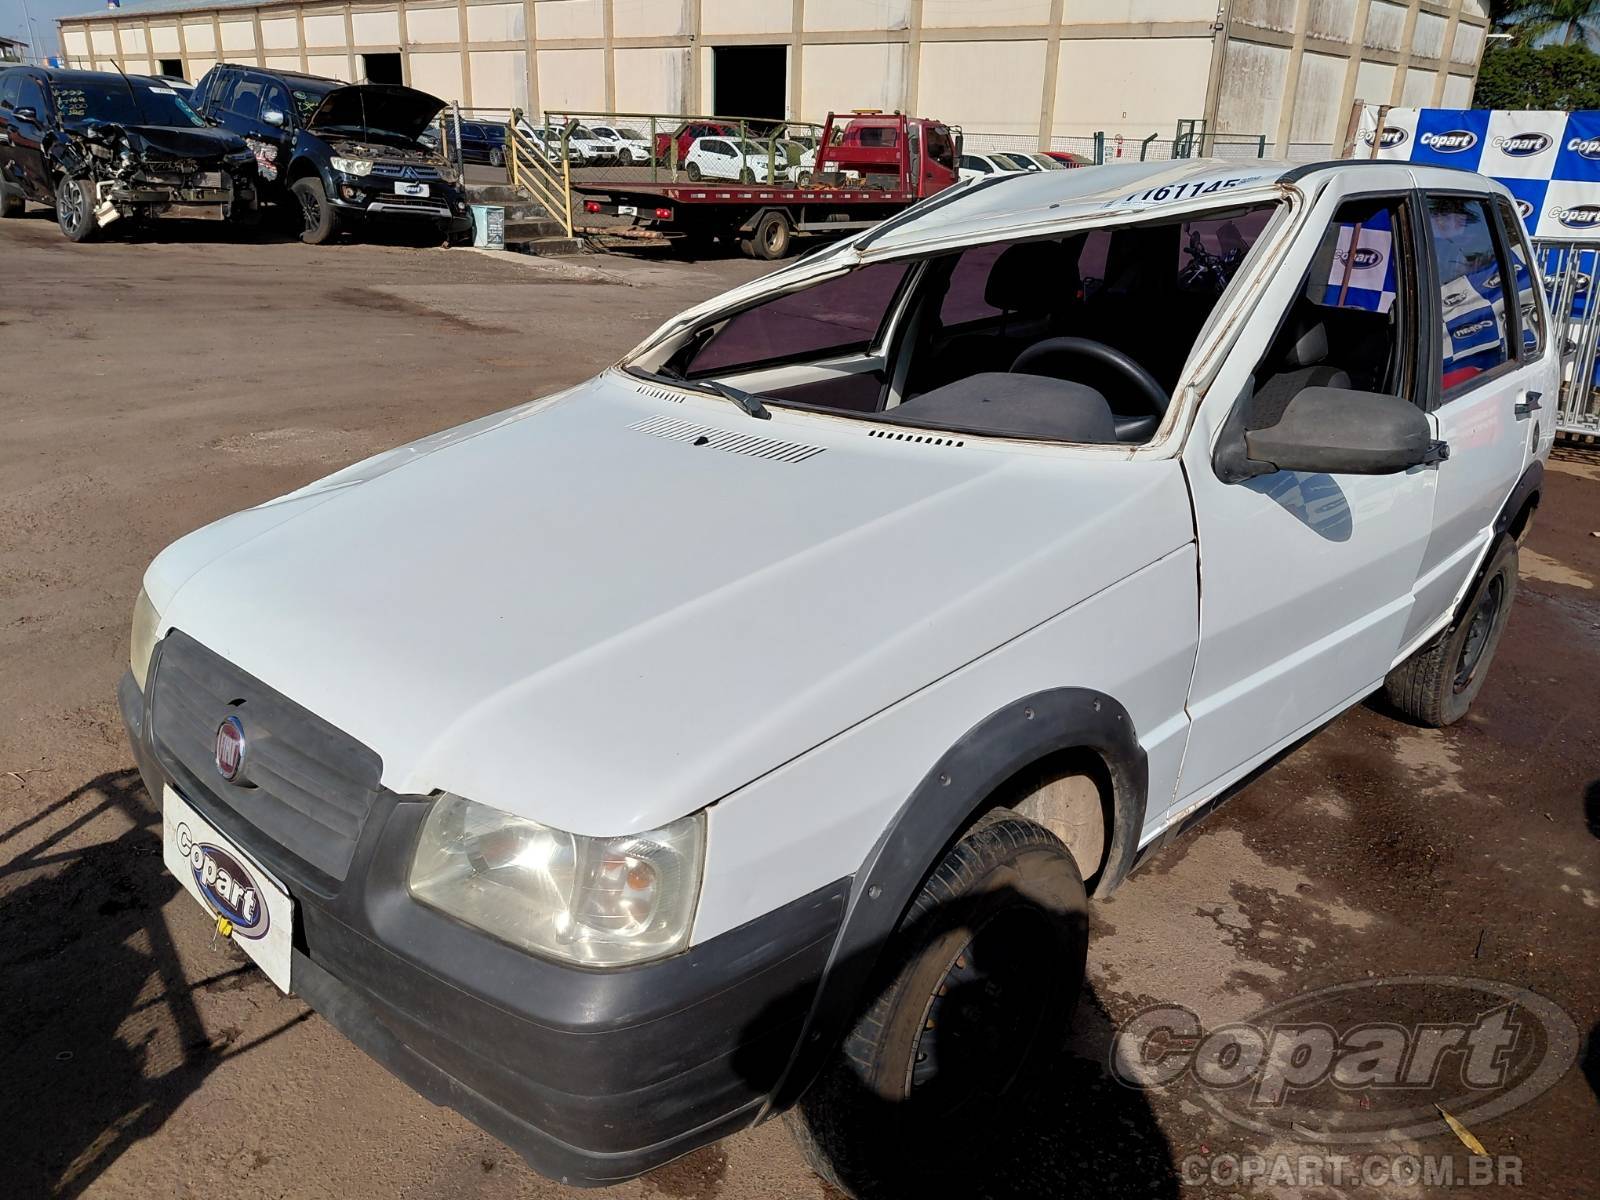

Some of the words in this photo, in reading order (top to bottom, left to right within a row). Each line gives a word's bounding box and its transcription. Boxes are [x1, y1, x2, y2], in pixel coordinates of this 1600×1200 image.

[1420, 132, 1471, 148] Copart
[1491, 136, 1546, 152] Copart
[1567, 137, 1600, 154] Cop
[1548, 206, 1600, 223] Copart
[1333, 249, 1376, 264] Coart
[176, 822, 256, 925] Copart
